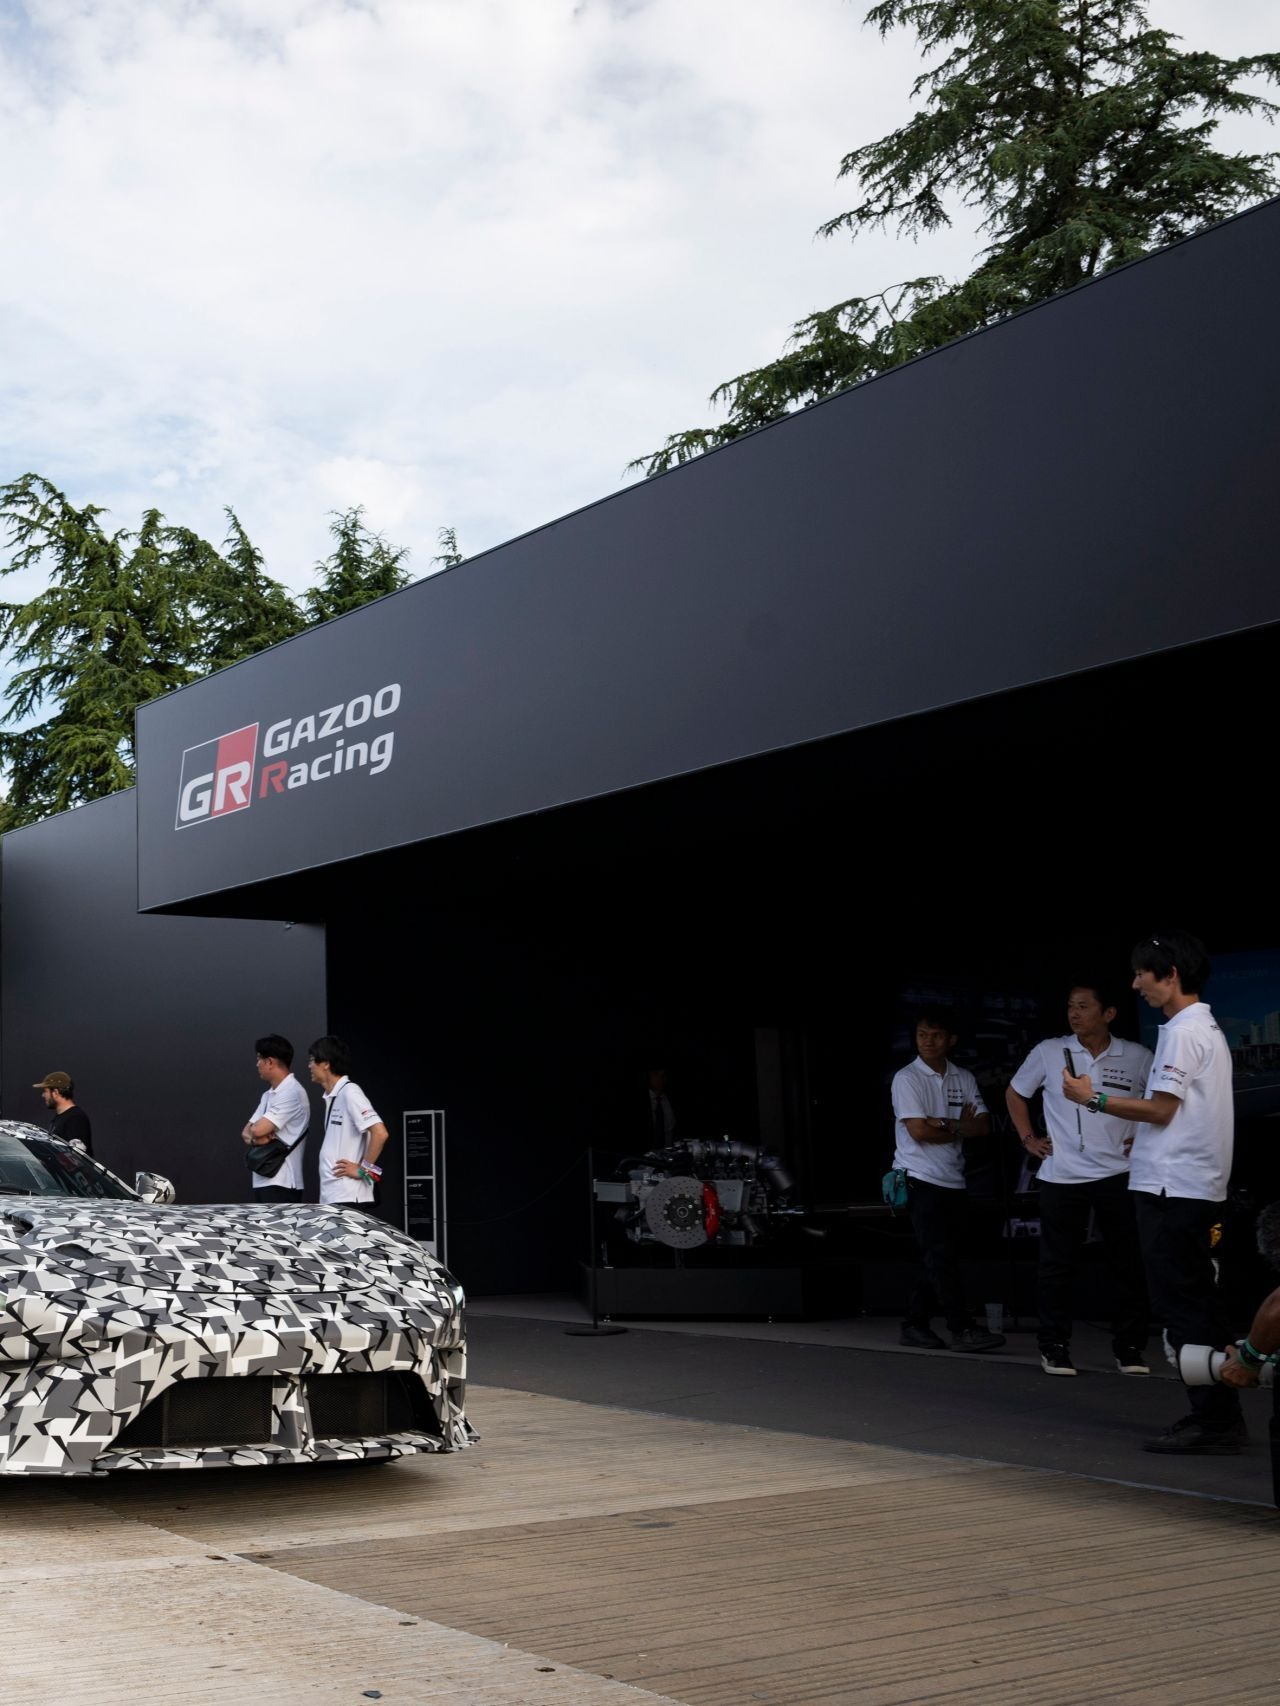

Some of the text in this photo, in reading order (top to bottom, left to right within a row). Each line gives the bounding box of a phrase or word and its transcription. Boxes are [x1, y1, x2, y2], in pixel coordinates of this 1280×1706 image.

[263, 683, 402, 758] GAZOO
[179, 760, 251, 822] GR
[259, 731, 395, 799] Racing
